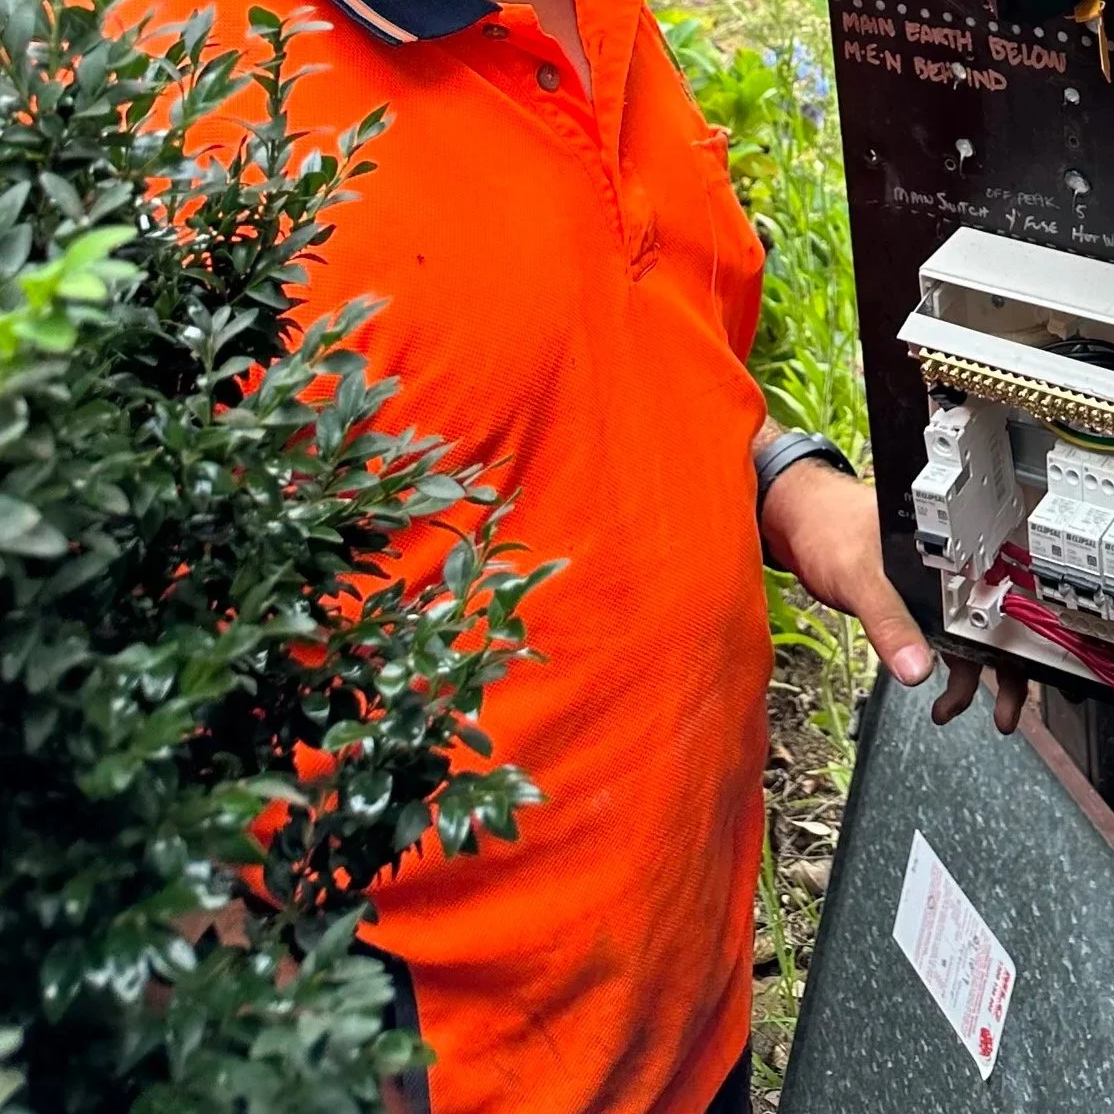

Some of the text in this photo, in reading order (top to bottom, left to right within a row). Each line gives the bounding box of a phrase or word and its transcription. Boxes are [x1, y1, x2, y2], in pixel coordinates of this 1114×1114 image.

[842, 11, 1067, 73] MAIN EARTH BELOW
[1017, 192, 1060, 210] PEAK
[1036, 525, 1061, 538] CLIPSAL
[1071, 534, 1096, 548] CLIPSAL
